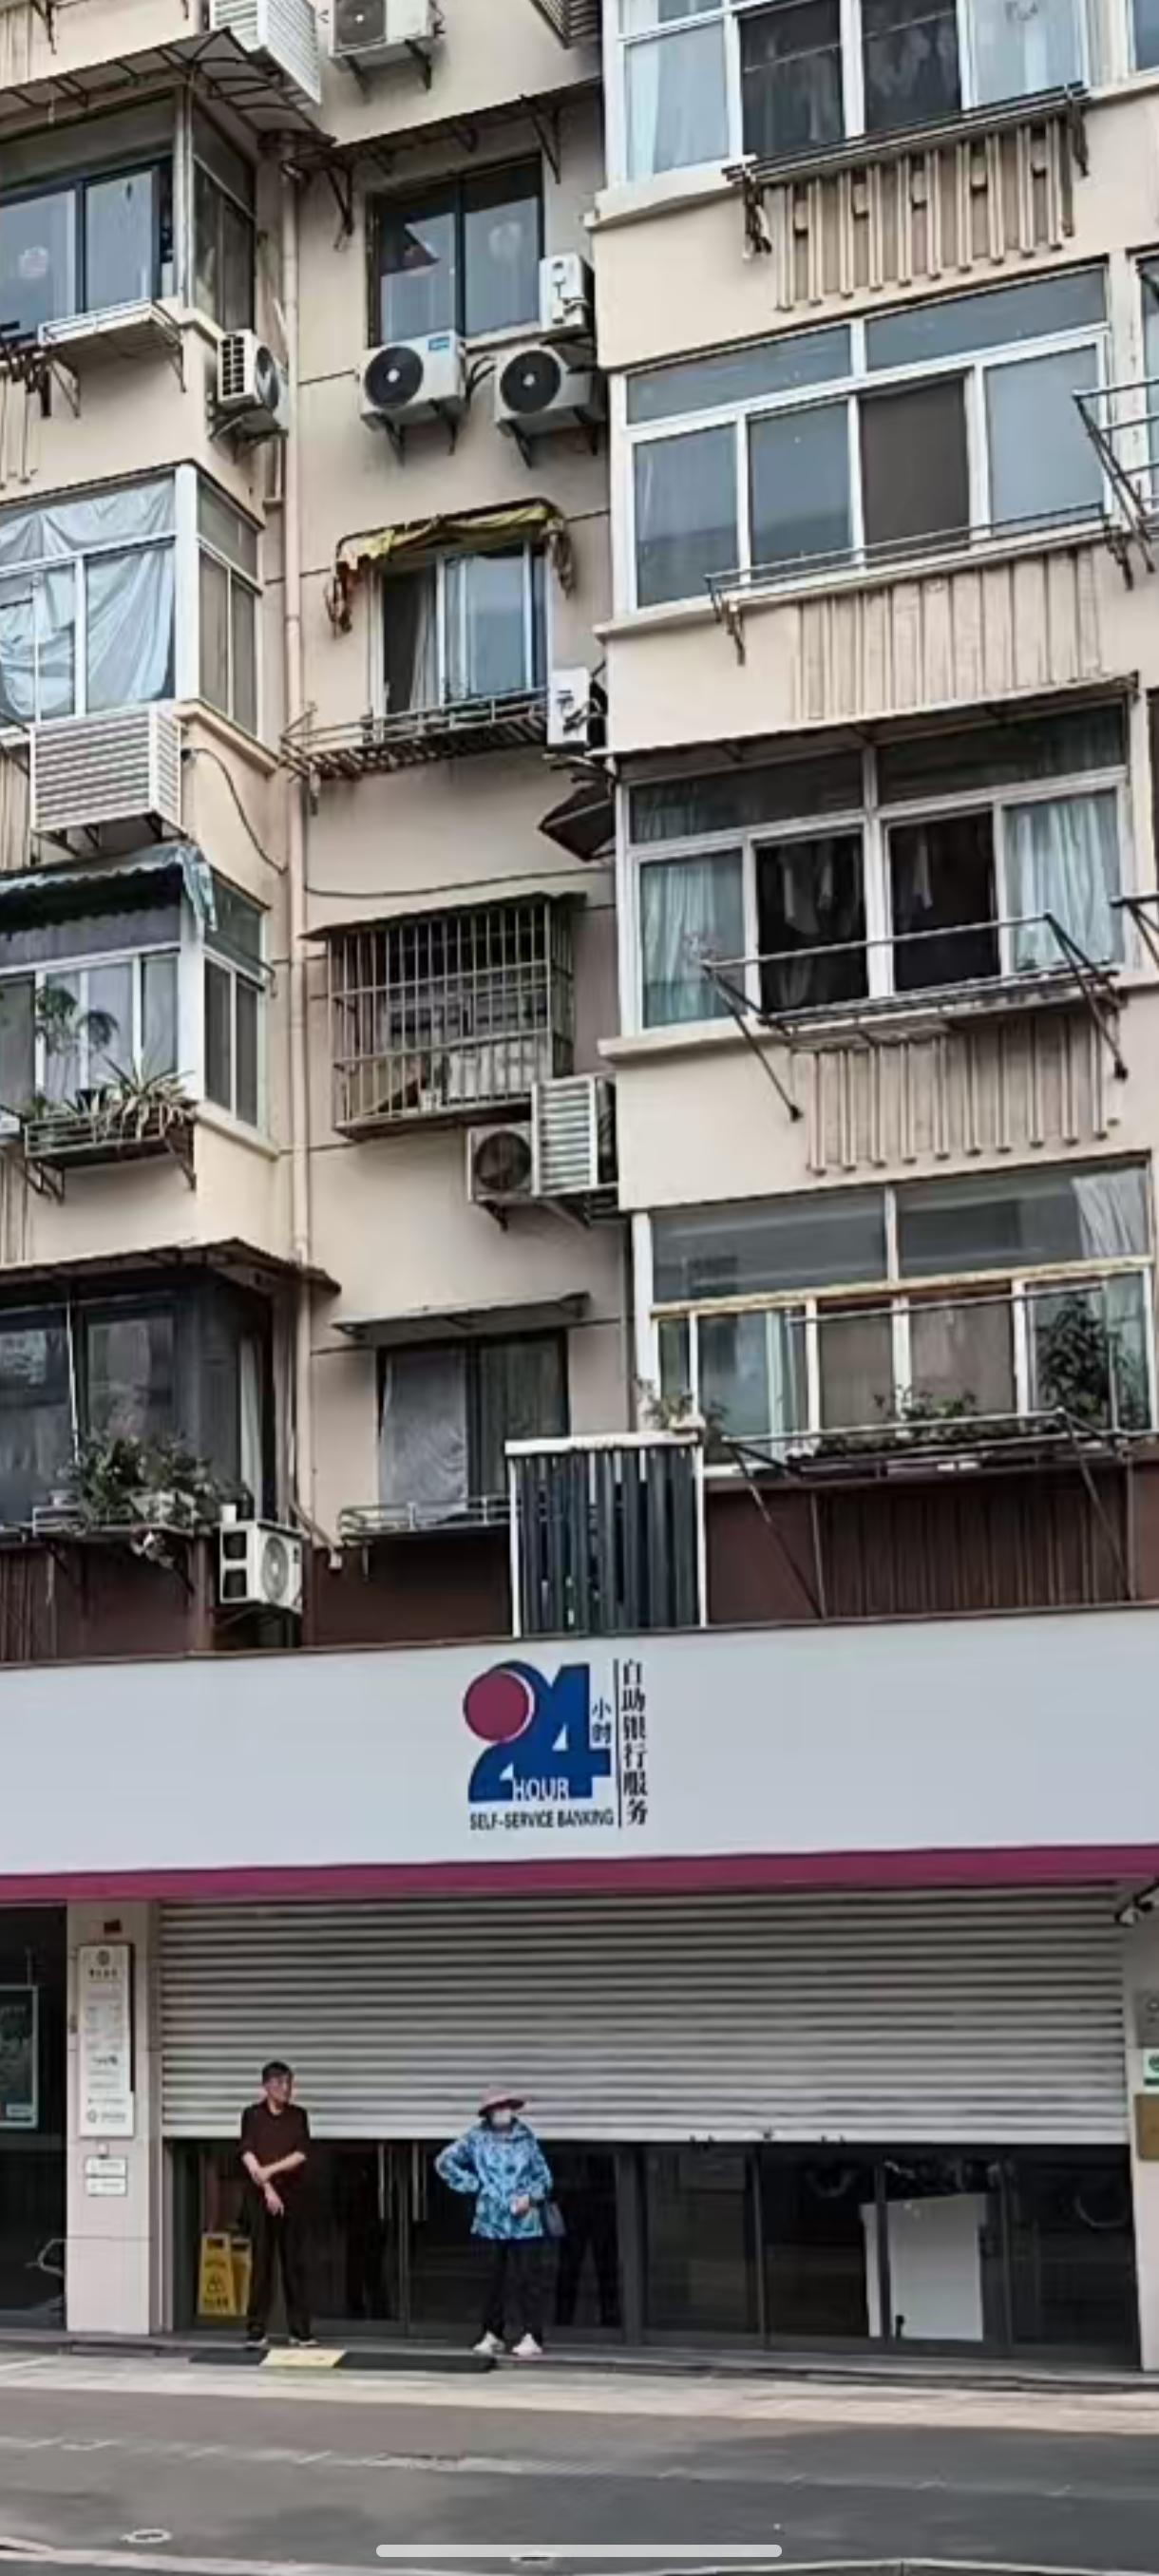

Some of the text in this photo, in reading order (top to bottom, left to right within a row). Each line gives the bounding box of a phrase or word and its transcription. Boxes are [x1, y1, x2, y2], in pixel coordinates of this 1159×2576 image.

[464, 1660, 611, 1803] 24
[592, 1697, 611, 1744] 小时
[621, 1658, 647, 1826] 自助银行服务
[513, 1777, 569, 1802] HOUR
[469, 1808, 615, 1830] SELF-SERVICE BANKING
